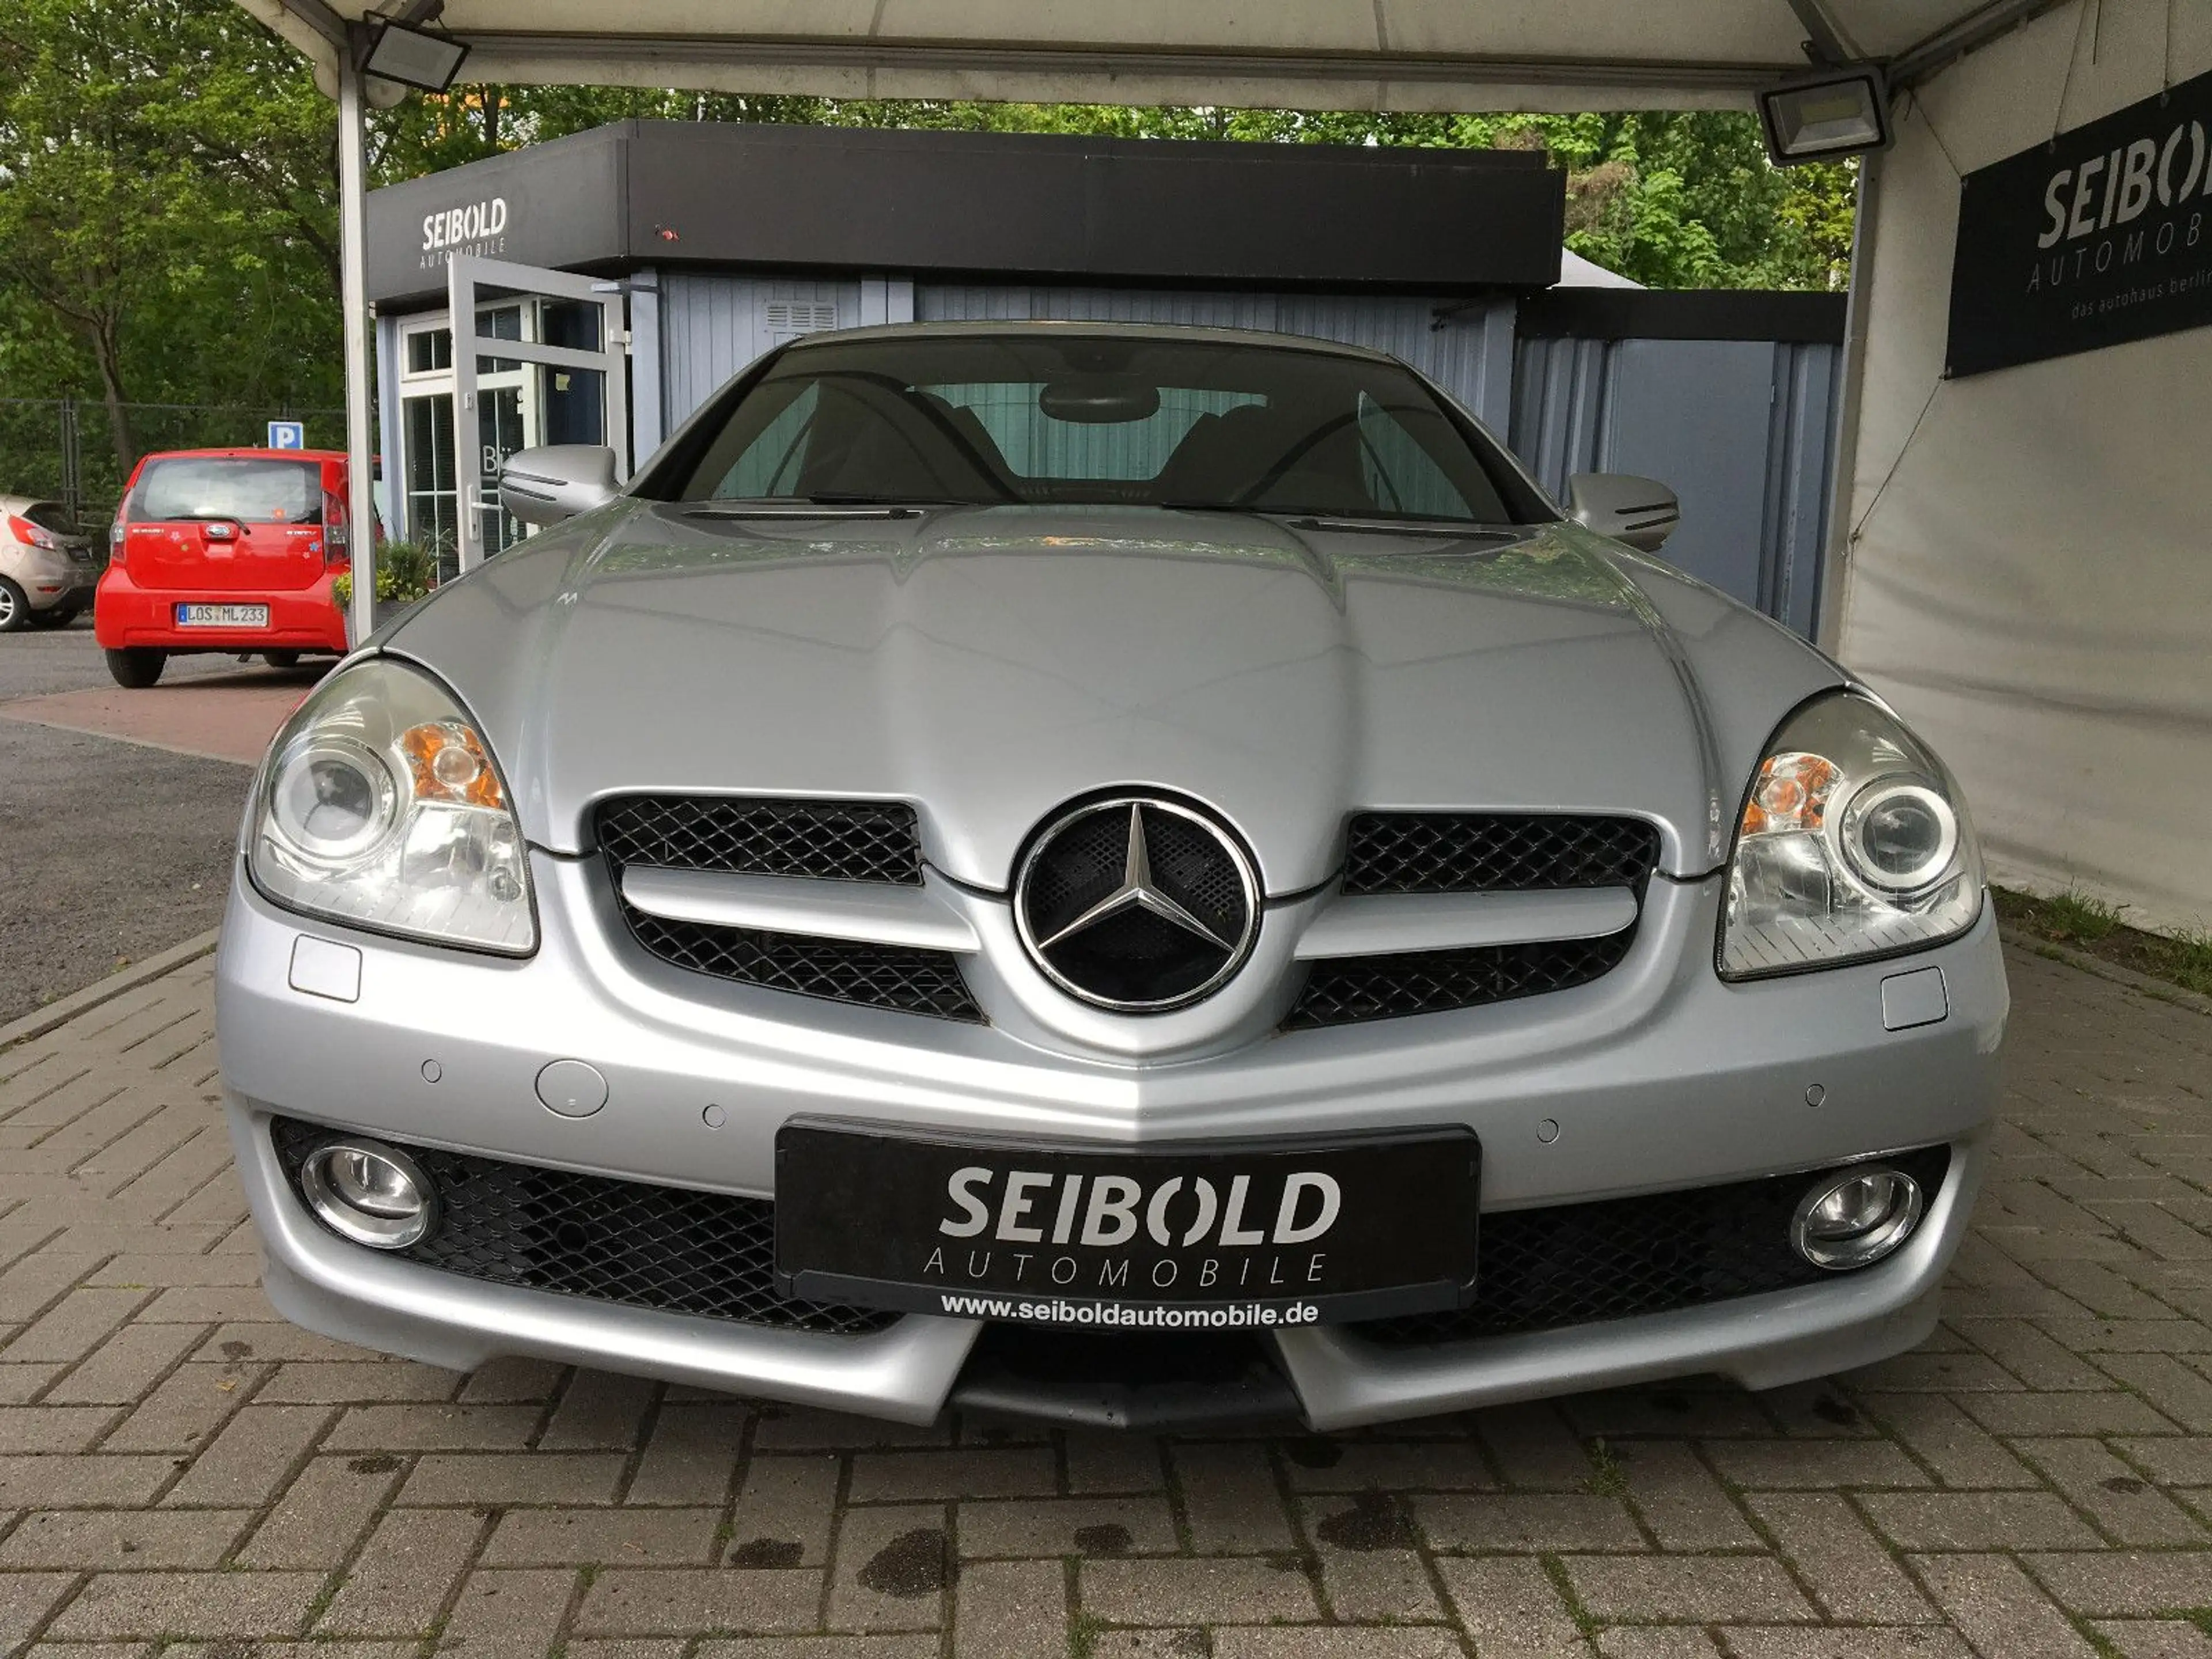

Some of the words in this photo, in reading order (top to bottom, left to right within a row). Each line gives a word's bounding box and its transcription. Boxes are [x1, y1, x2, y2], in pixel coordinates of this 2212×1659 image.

[423, 198, 506, 250] SEIBOLD
[277, 427, 294, 449] P
[188, 607, 212, 620] LOS
[222, 608, 238, 621] ML
[241, 608, 264, 622] 233
[939, 1166, 1340, 1247] SEIBOLD
[923, 1247, 1326, 1287] AUTOMOBILE
[941, 1295, 1319, 1327] www.seiboldautomobile.de
